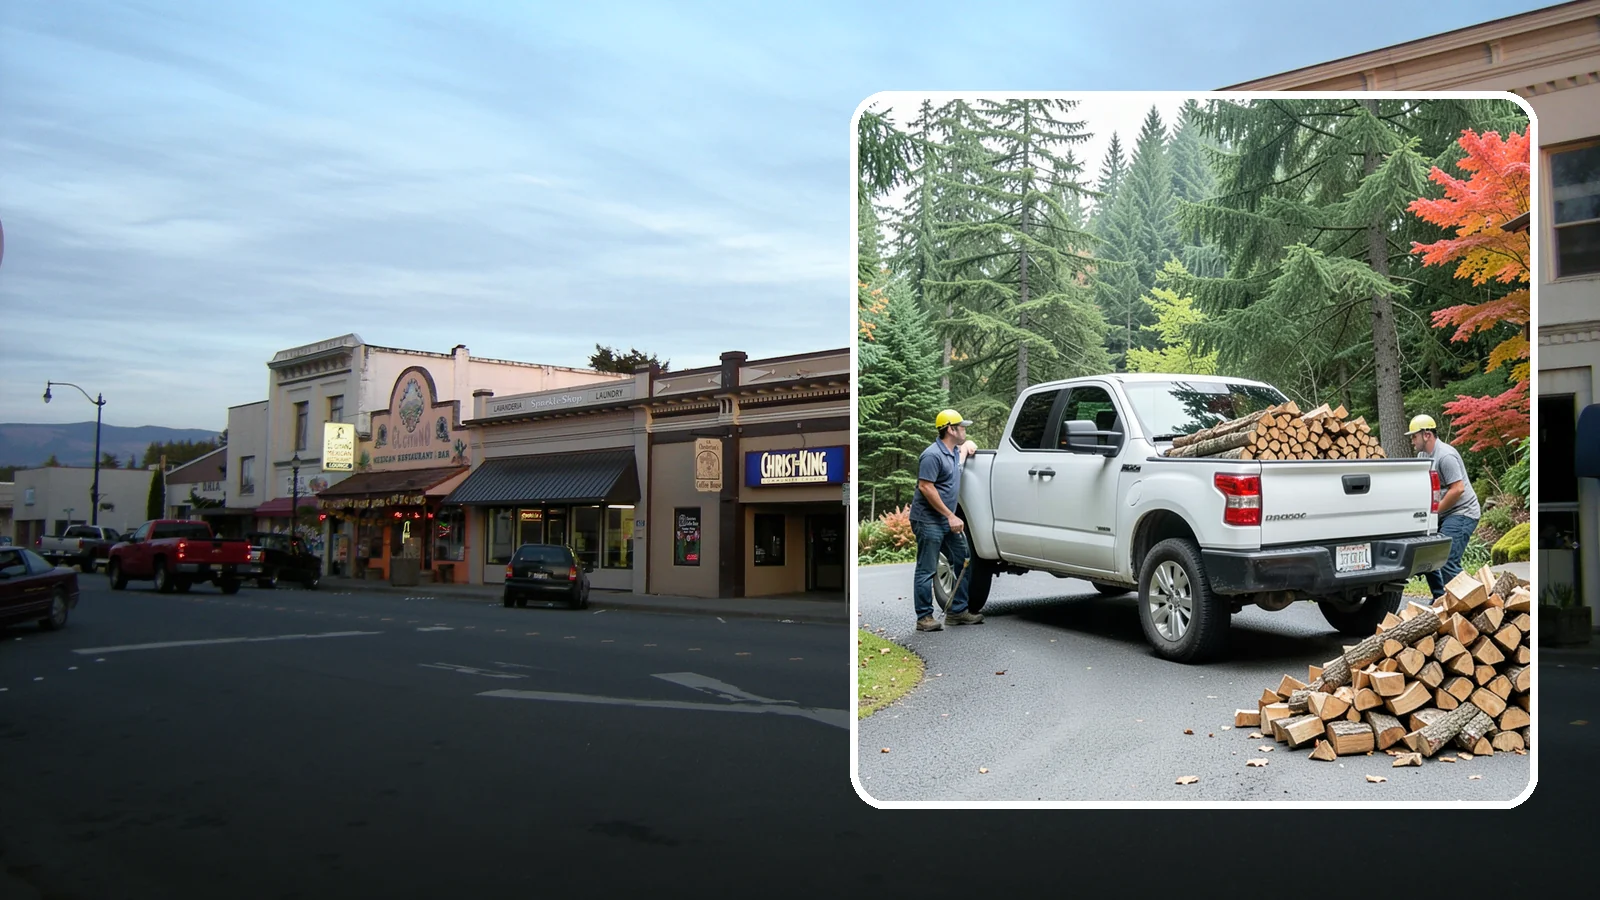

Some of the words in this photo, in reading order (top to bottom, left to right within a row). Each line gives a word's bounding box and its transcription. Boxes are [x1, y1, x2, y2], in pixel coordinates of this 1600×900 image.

[561, 395, 583, 405] Shop
[595, 389, 623, 400] LAUNDRY
[494, 403, 523, 413] LAVANDERIA
[373, 455, 396, 464] MEXICAN
[397, 451, 433, 462] RESTAURANT
[438, 450, 450, 459] BAR
[799, 450, 828, 477] KING
